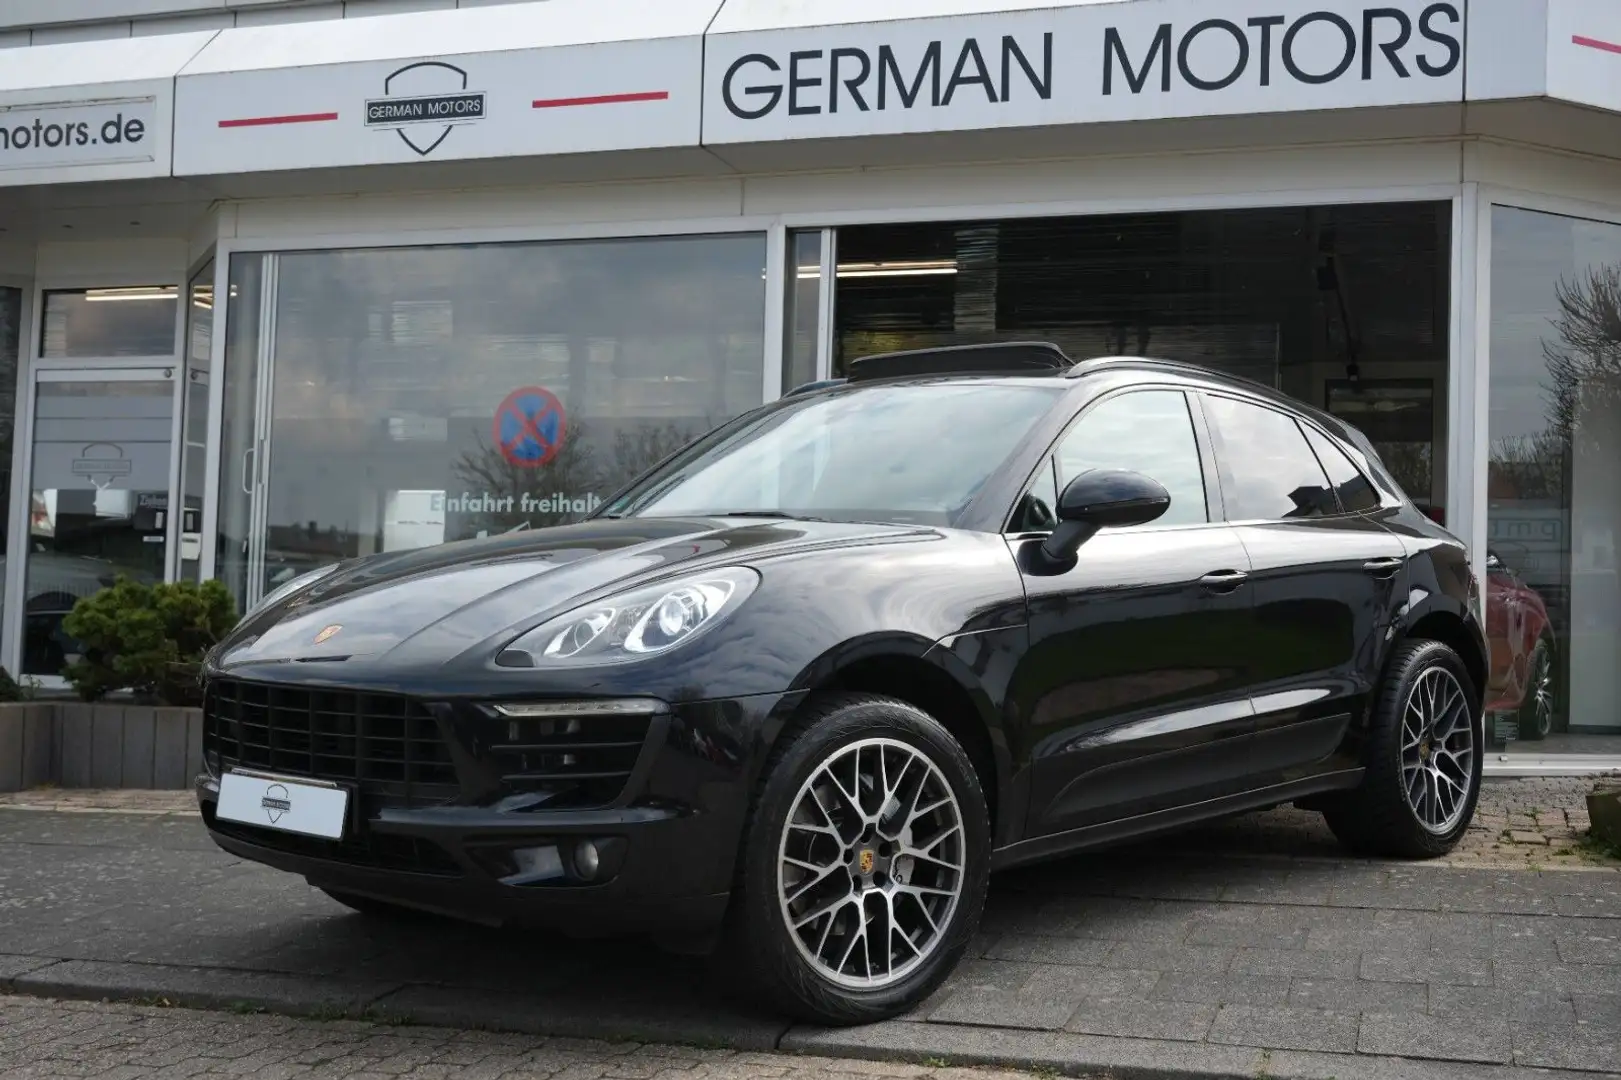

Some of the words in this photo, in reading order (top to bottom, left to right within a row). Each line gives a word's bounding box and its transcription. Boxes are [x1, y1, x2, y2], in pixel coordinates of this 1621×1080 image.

[721, 32, 1052, 120] GERMAN
[1101, 2, 1462, 96] MOTORS
[369, 103, 423, 119] GERMAN
[427, 99, 481, 115] MOTORS
[430, 491, 514, 513] Einfahrt
